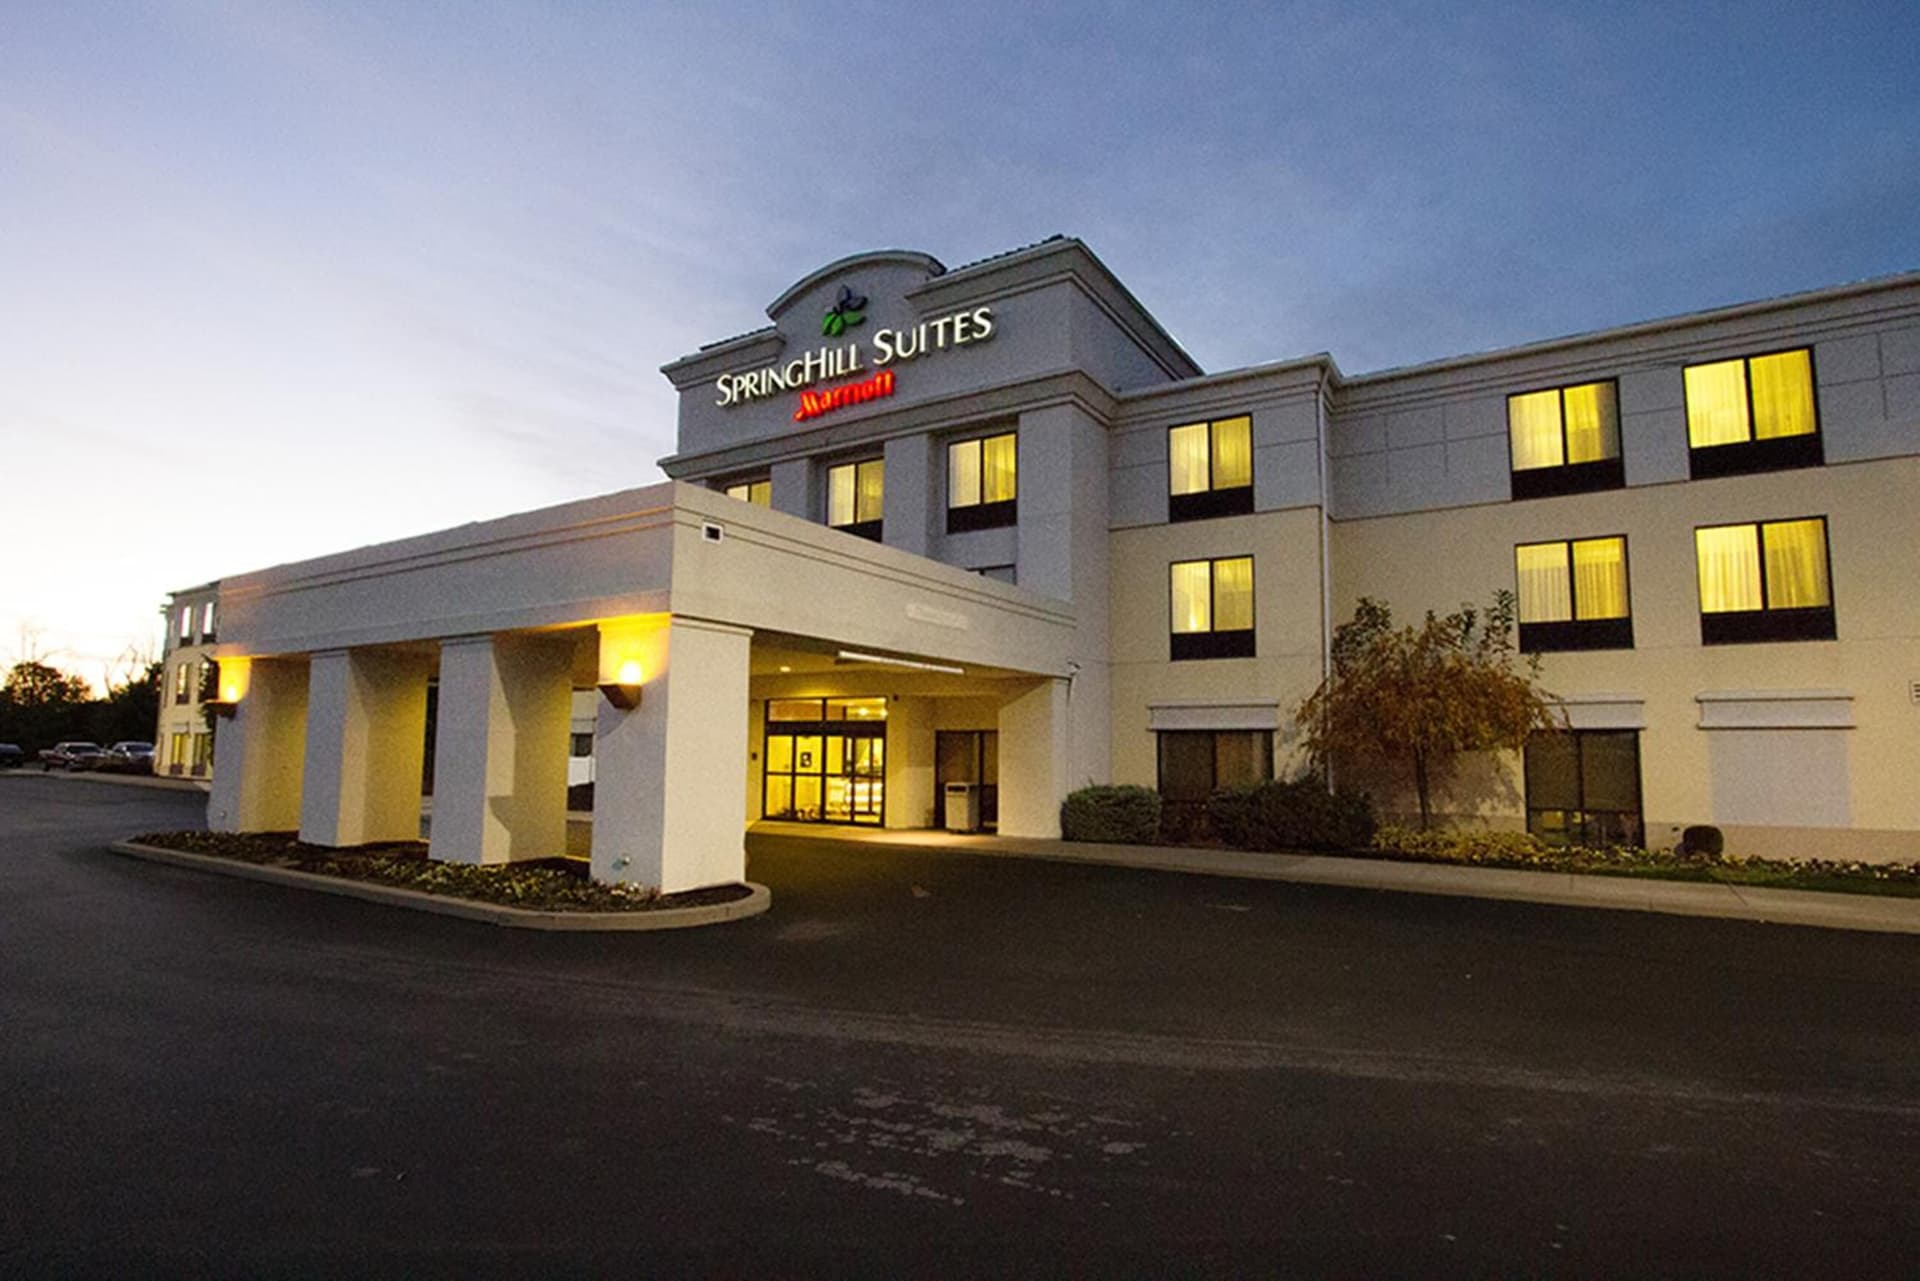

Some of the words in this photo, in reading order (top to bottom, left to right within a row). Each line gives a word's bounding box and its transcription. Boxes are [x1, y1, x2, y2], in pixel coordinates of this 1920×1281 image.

[715, 342, 861, 407] SPRINGHILL
[872, 307, 993, 366] SUITES
[793, 369, 895, 422] Marriott
